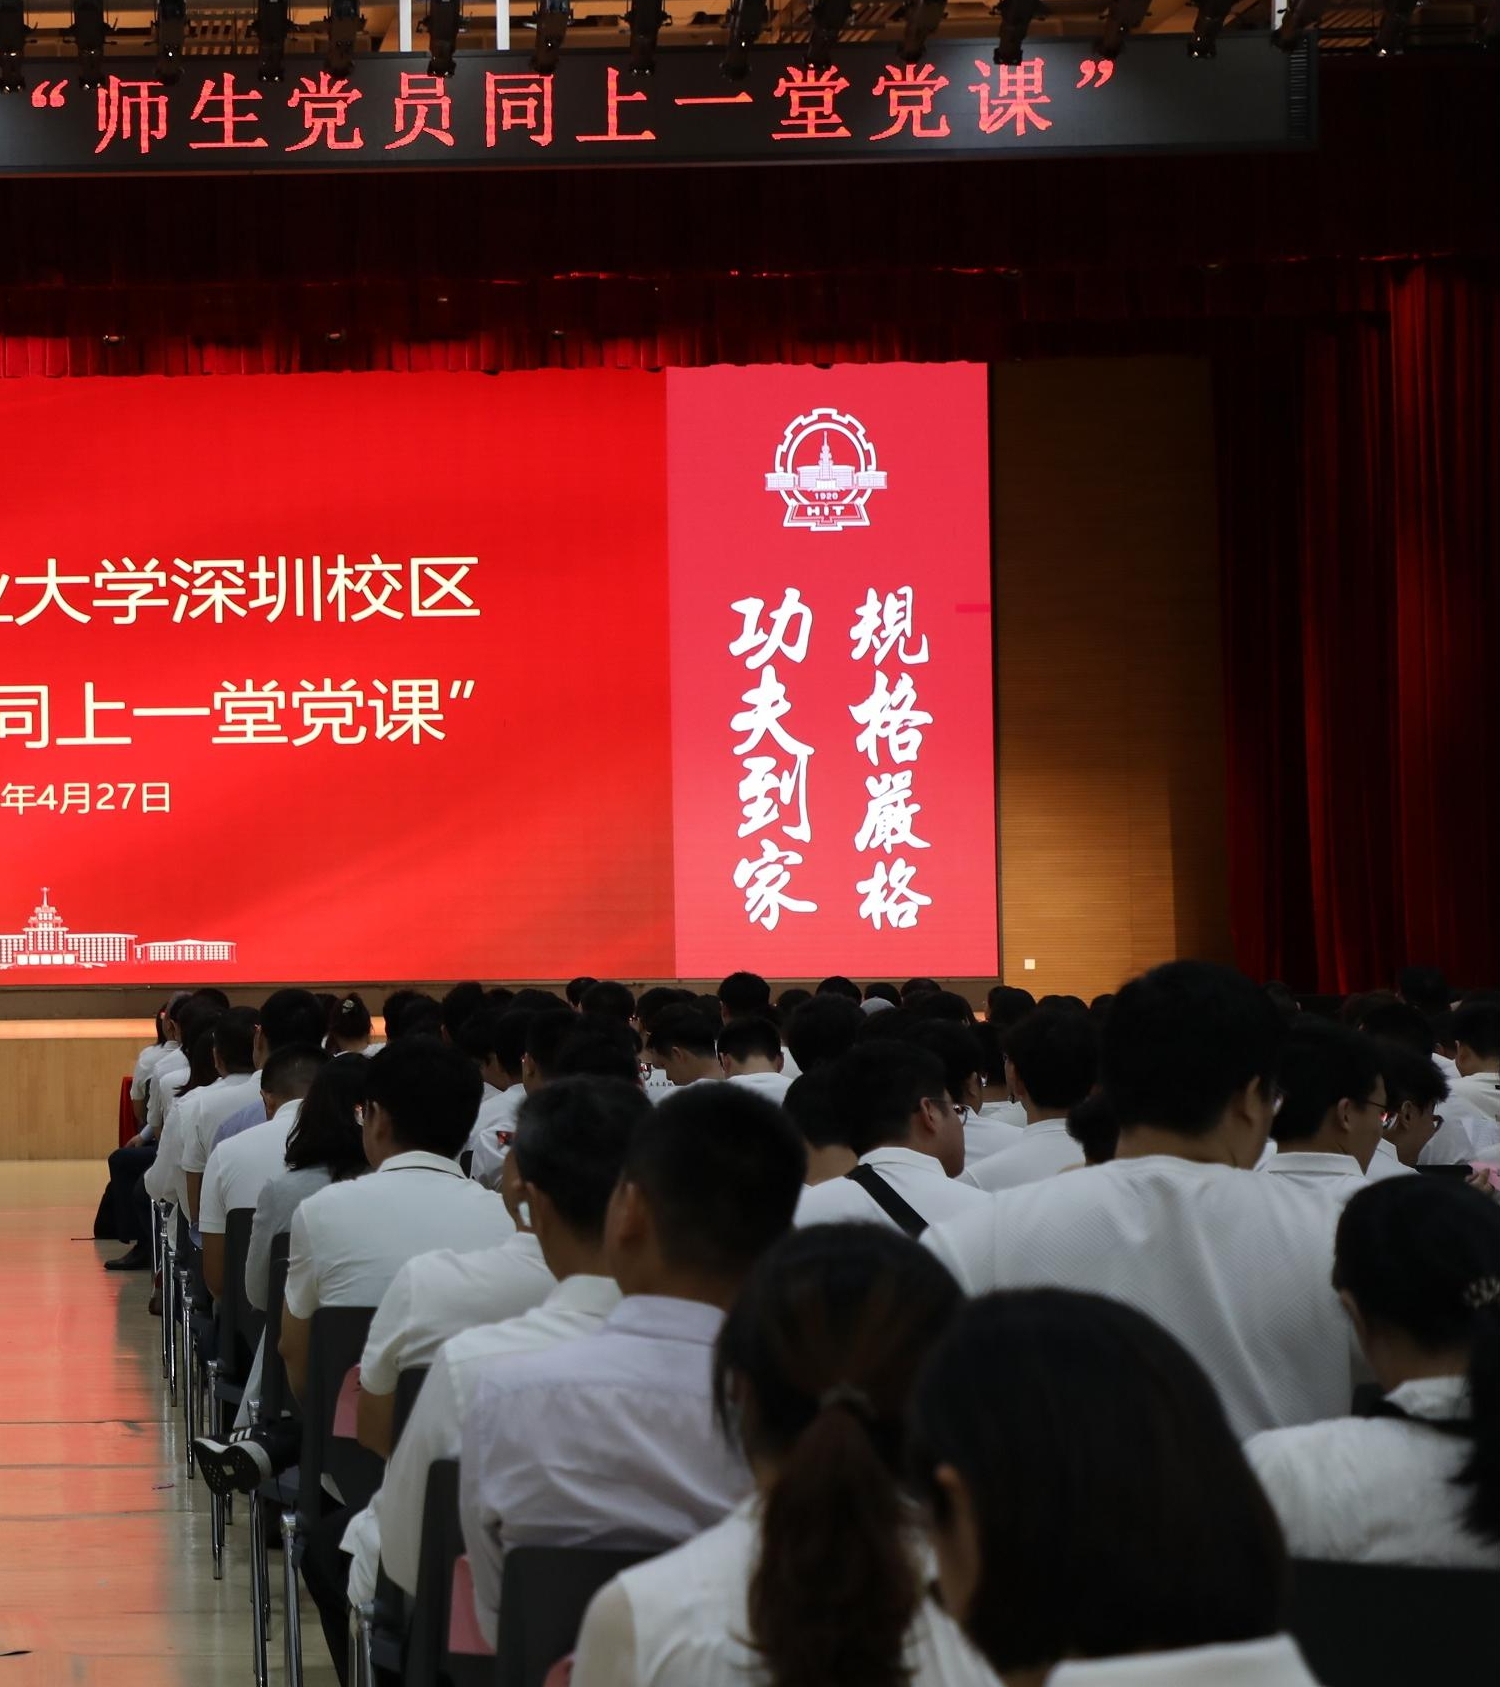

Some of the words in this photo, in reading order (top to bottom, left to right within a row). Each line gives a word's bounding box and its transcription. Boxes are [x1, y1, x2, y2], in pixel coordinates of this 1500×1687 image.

[807, 505, 845, 516] HIT
[728, 587, 818, 931] 功夫到家
